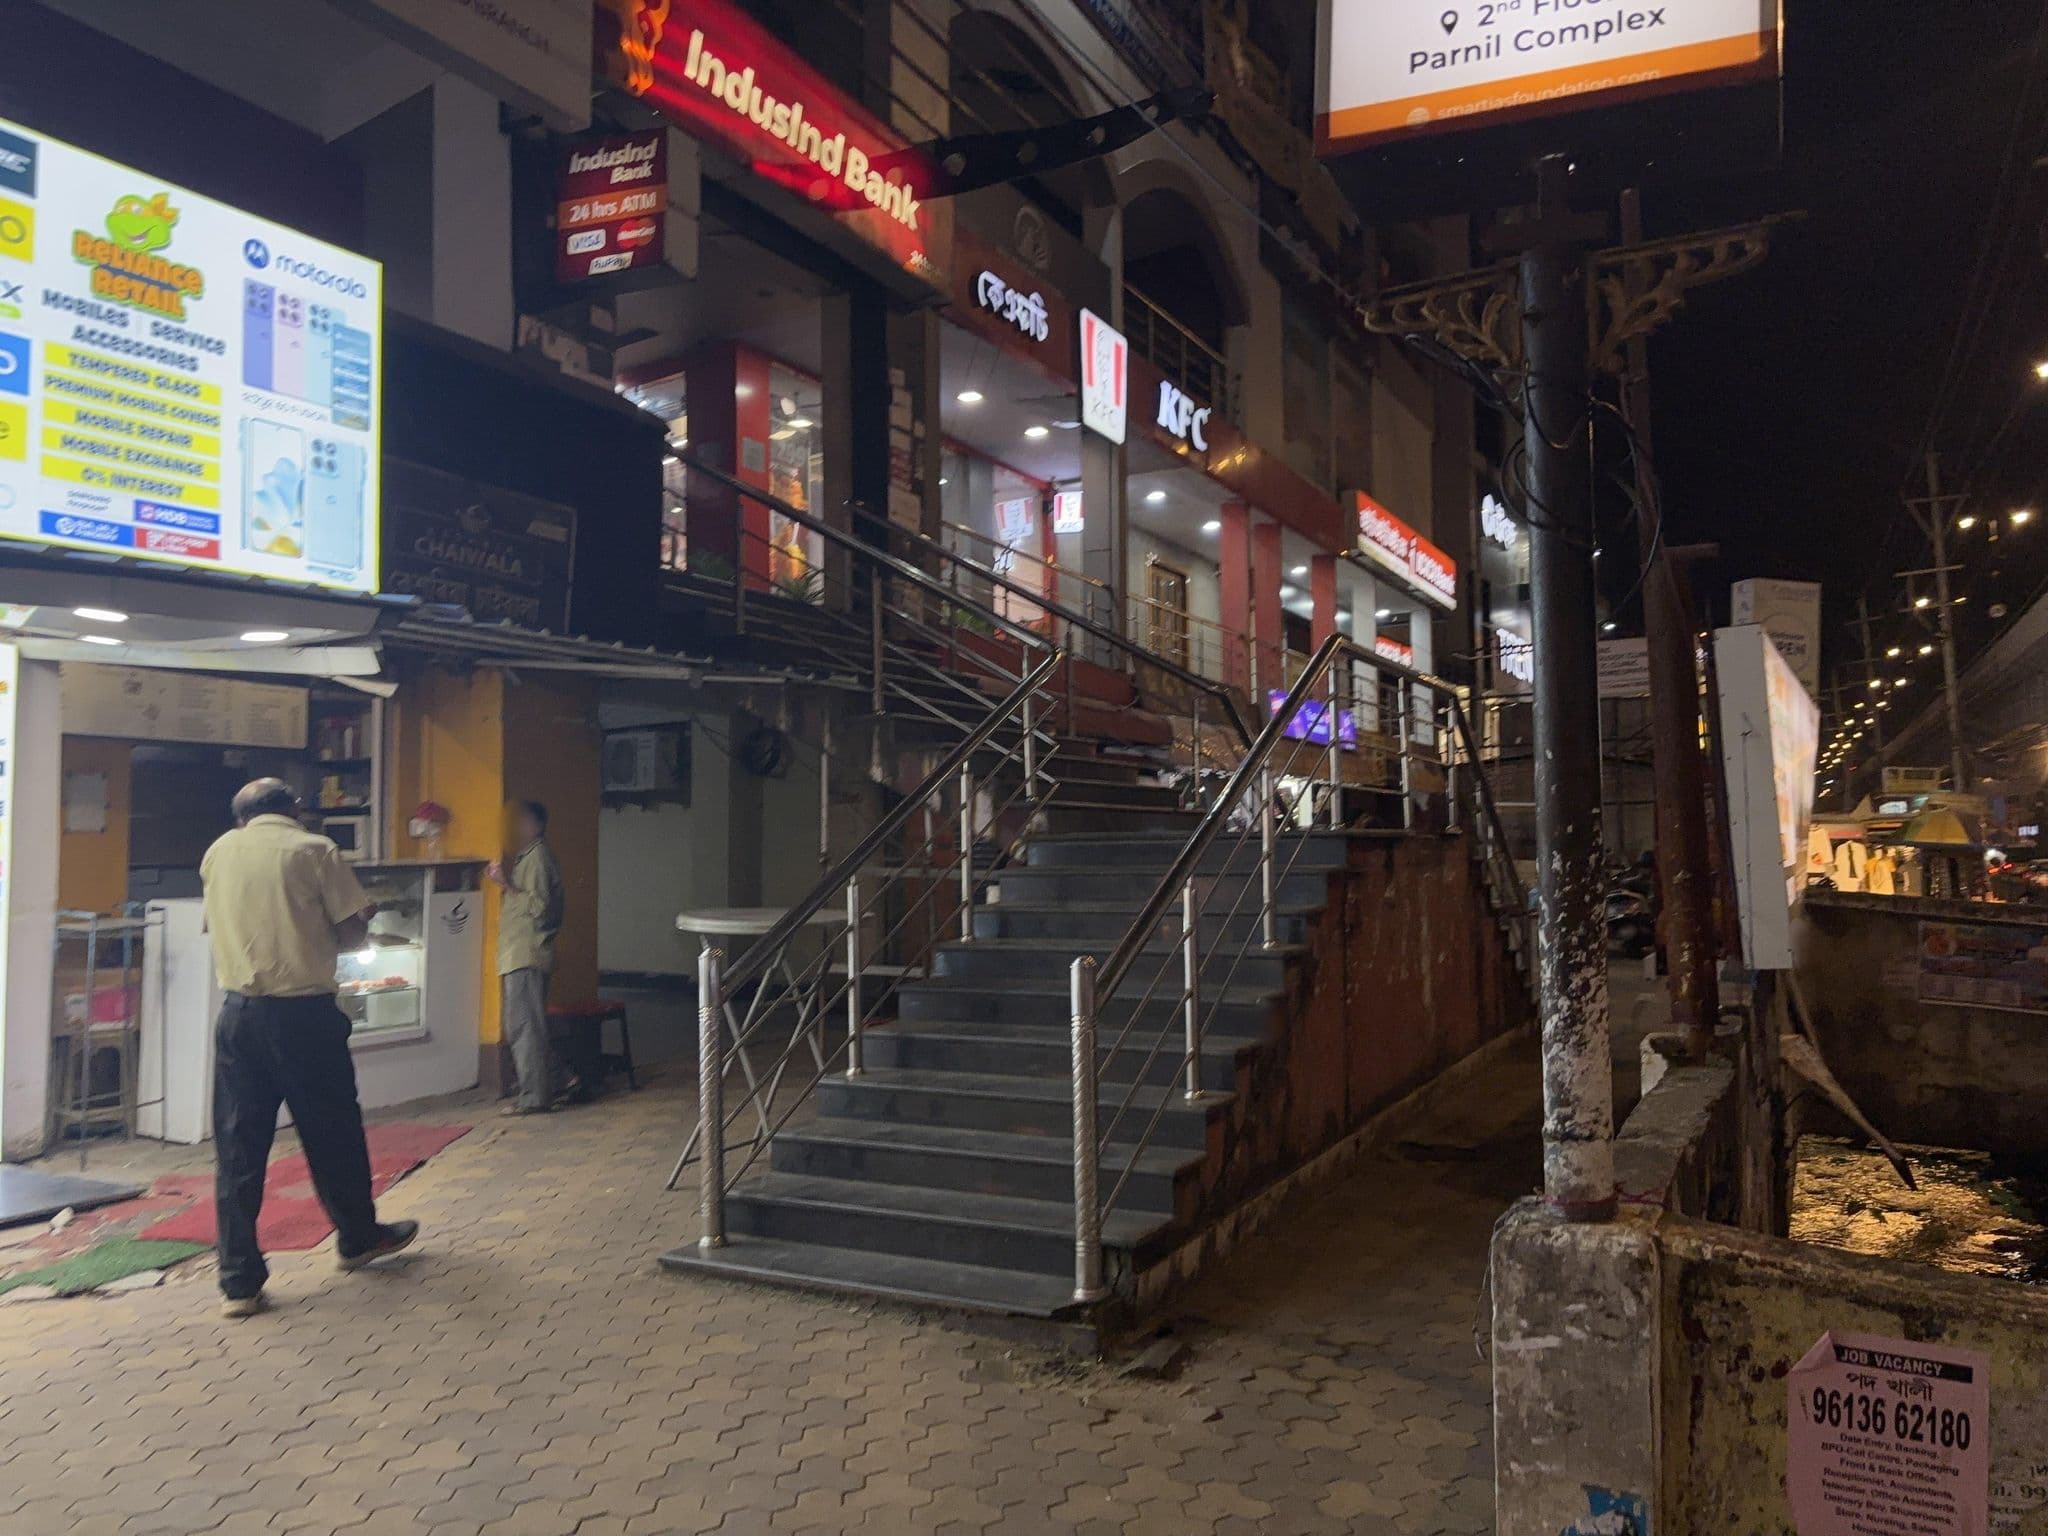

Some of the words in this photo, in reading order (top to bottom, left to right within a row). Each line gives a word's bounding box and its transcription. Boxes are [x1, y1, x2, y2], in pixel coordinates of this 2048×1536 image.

[1409, 34, 1500, 74] Parnil
[1514, 8, 1665, 52] Complex
[684, 29, 845, 177] IndusInd
[844, 146, 920, 231] Bank
[568, 137, 659, 175] IndusInd
[610, 161, 653, 184] Bank
[569, 205, 590, 223] 24
[591, 200, 618, 218] hrs
[619, 191, 657, 215] ATM
[276, 255, 367, 298] motorola
[75, 410, 134, 434] MOBILE
[1156, 379, 1212, 451] KFC
[61, 434, 121, 459] MOBILE
[1840, 1349, 1868, 1364] JOB
[1875, 1352, 1943, 1377] VACANCY
[1846, 1372, 1878, 1392] পদ
[1813, 1386, 1886, 1435] 96136
[1895, 1401, 1971, 1450] 62180
